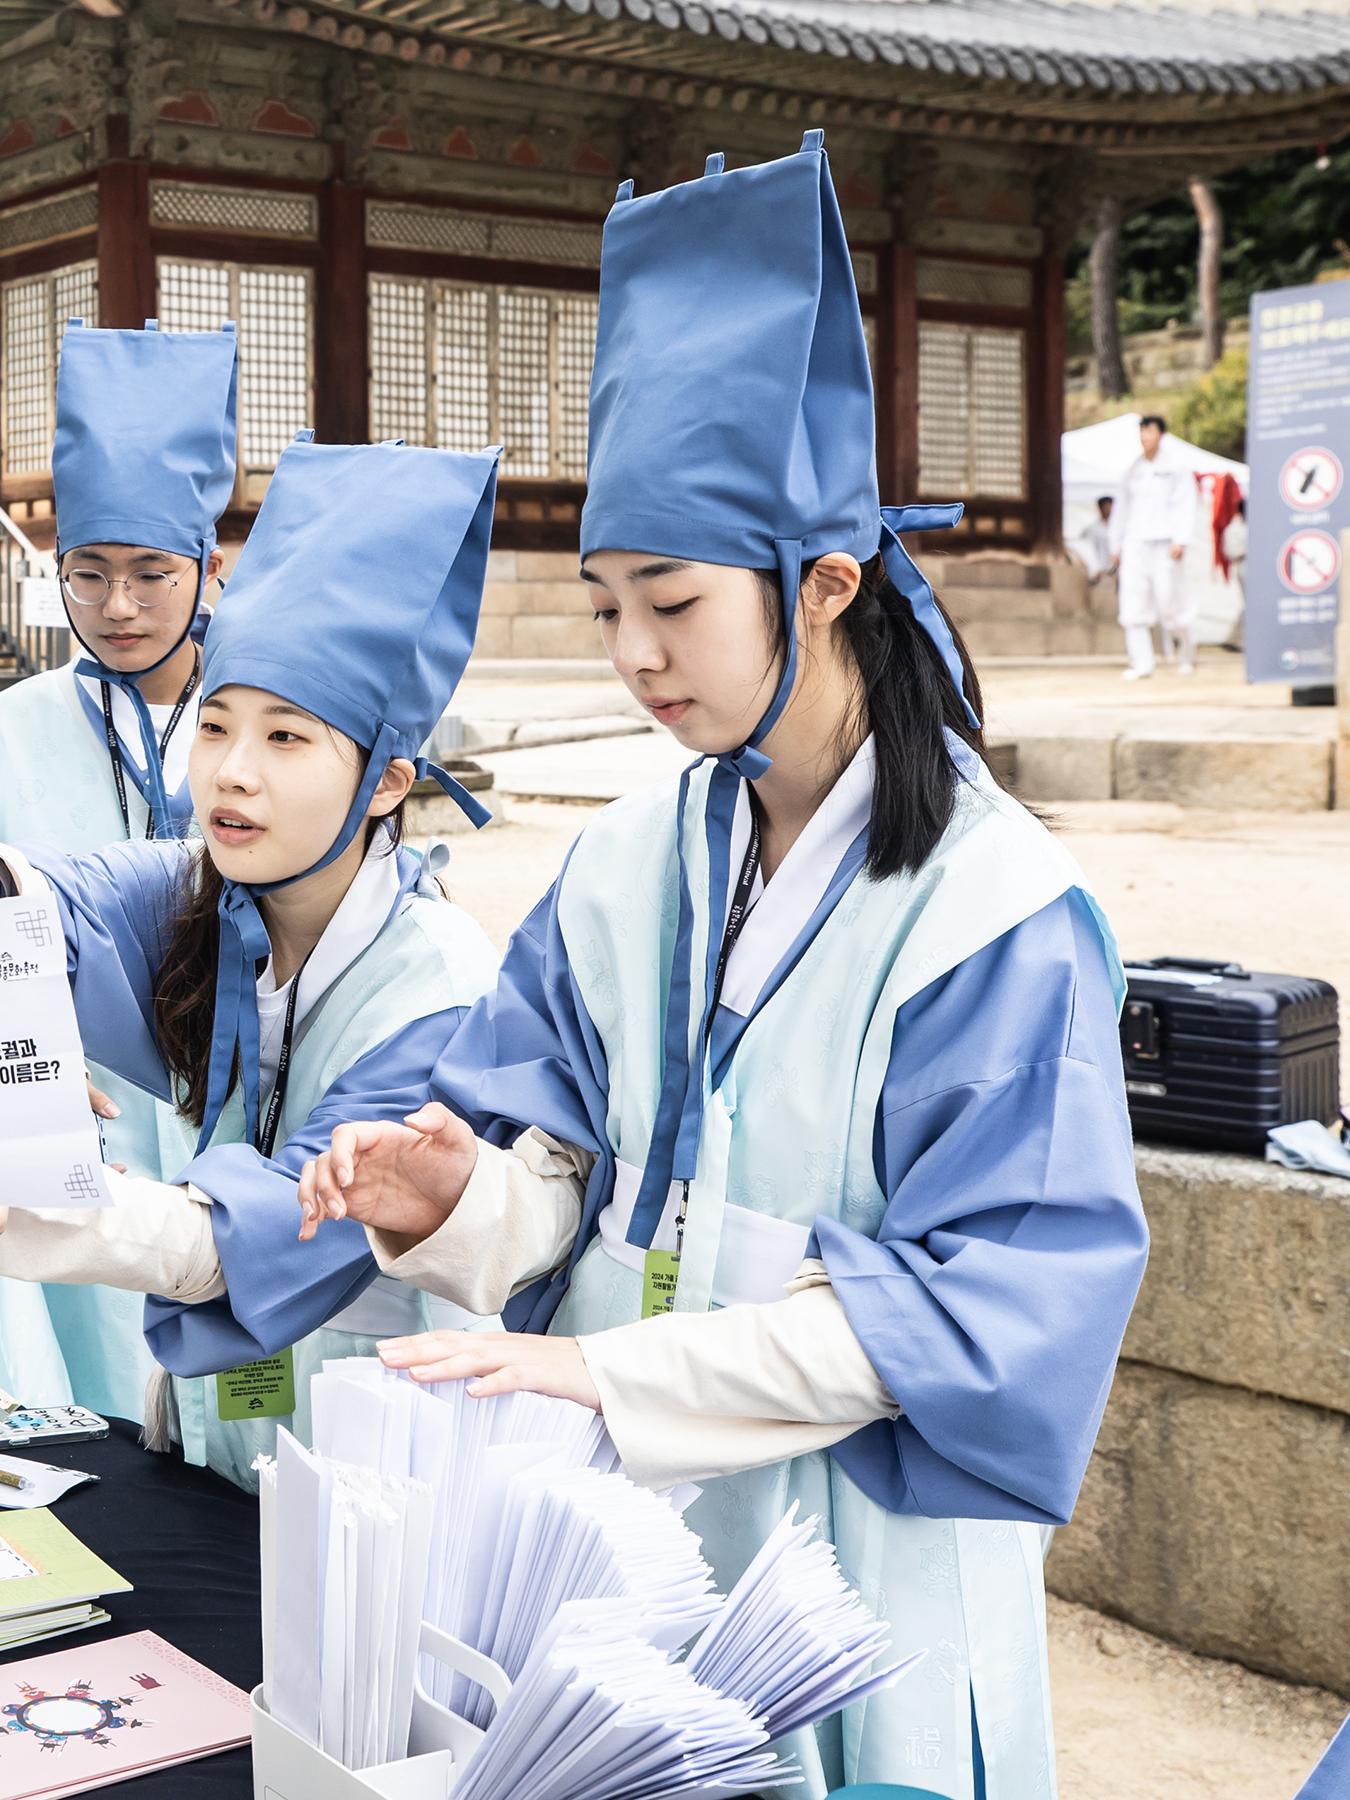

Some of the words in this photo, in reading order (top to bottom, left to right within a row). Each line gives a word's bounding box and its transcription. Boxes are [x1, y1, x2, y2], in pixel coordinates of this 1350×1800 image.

[750, 833, 760, 859] Culture
[742, 857, 756, 886] Festival
[0, 1060, 61, 1085] 이름은?
[264, 1115, 275, 1138] Culture
